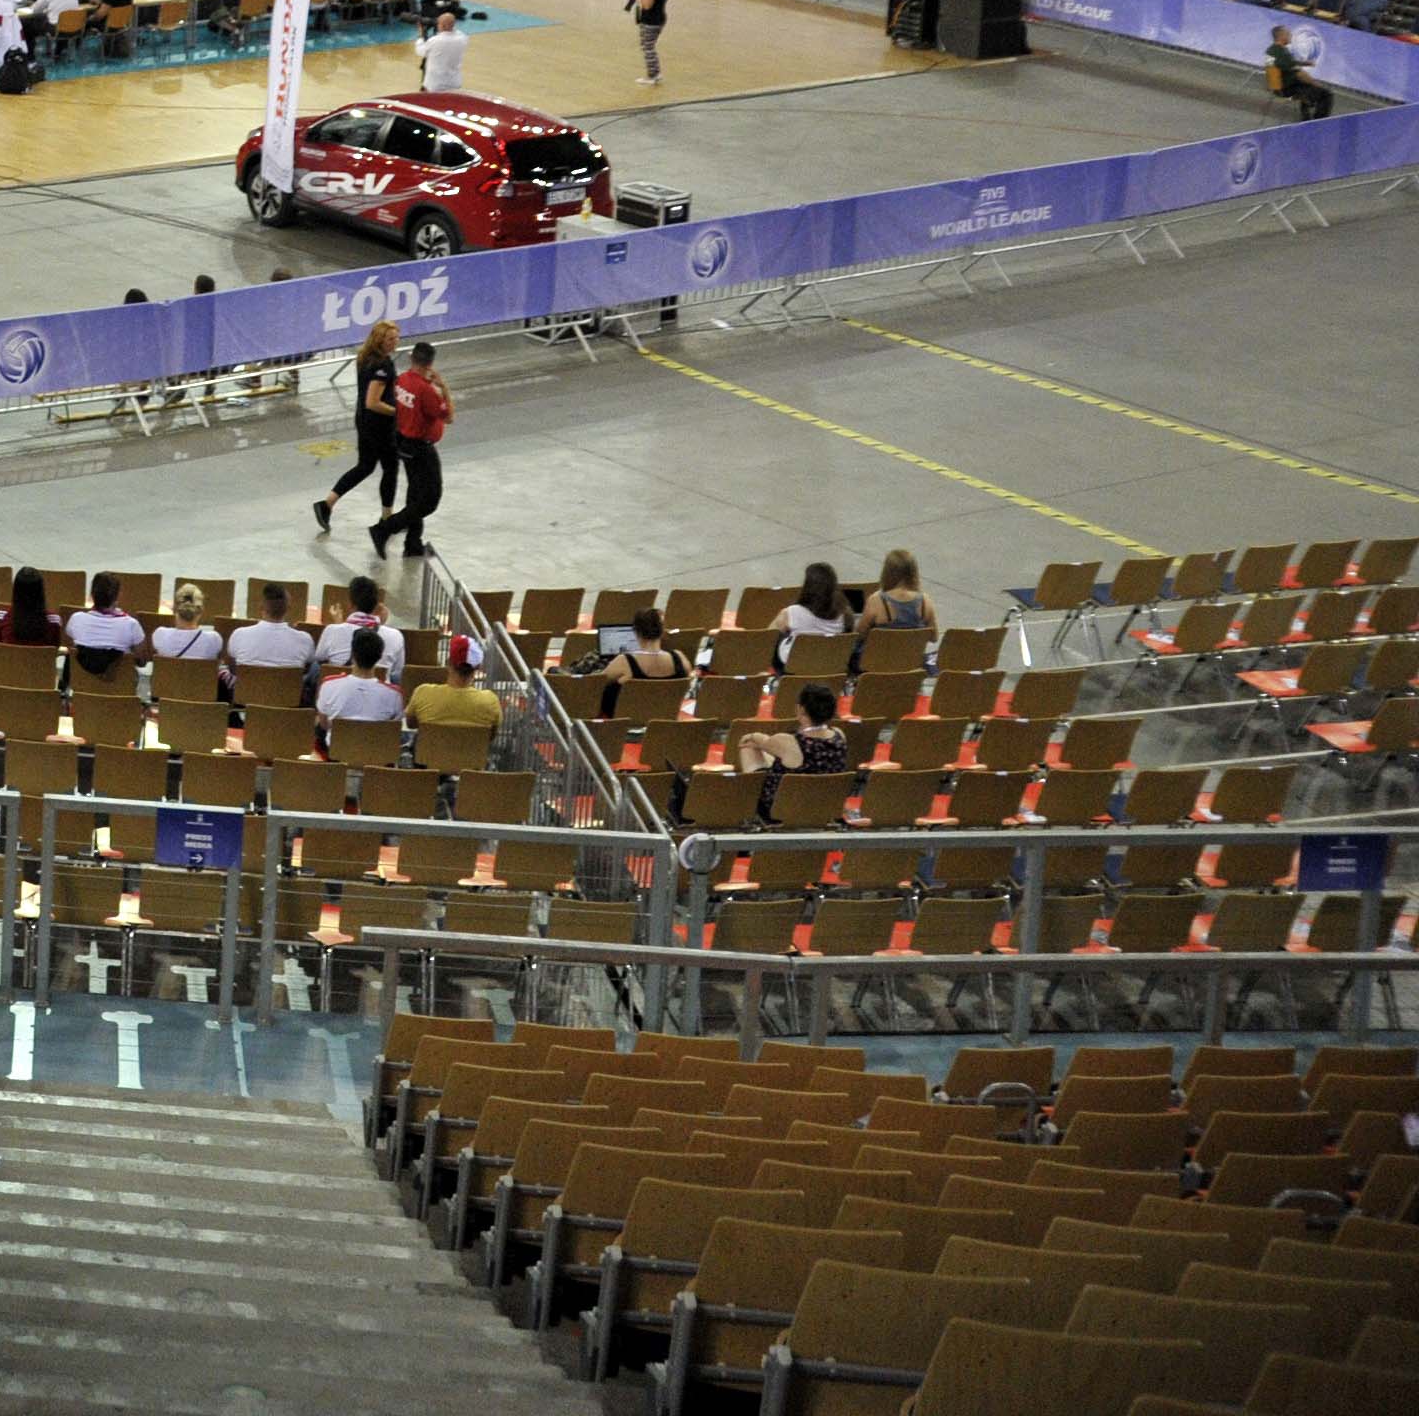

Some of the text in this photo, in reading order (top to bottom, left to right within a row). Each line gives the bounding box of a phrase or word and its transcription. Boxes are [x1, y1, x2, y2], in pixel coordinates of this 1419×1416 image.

[299, 171, 395, 196] CR-V
[978, 185, 1006, 201] FIVB
[929, 205, 1053, 240] WORLD LEAGUE
[321, 266, 450, 332] ŁÓDŹ
